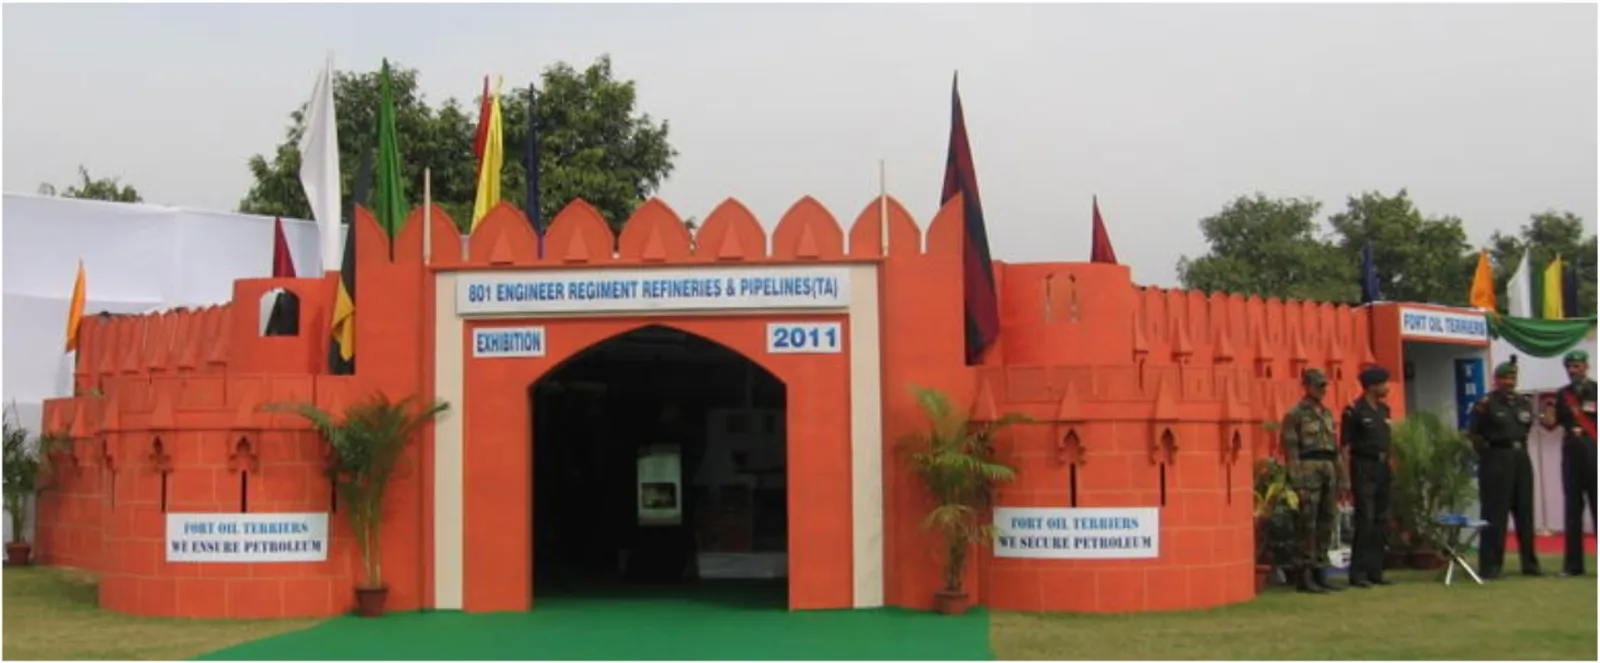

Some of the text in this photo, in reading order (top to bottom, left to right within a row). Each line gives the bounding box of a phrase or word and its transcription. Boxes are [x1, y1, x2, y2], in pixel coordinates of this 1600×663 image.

[469, 277, 838, 302] 801 ENGINEER REGIMENT REFINERIES & PIPELINES(TA)
[1404, 314, 1486, 335] FORT OIL TERRIERS
[477, 331, 541, 353] EXHIBITION
[773, 327, 837, 348] 2011
[184, 522, 308, 534] FORT OIL TERRIERS
[1011, 517, 1139, 530] FORT OIL TERRIERS
[172, 540, 322, 554] WE ENSURE PETROLEUM
[999, 536, 1152, 549] WE SECURE PETROLEUM
